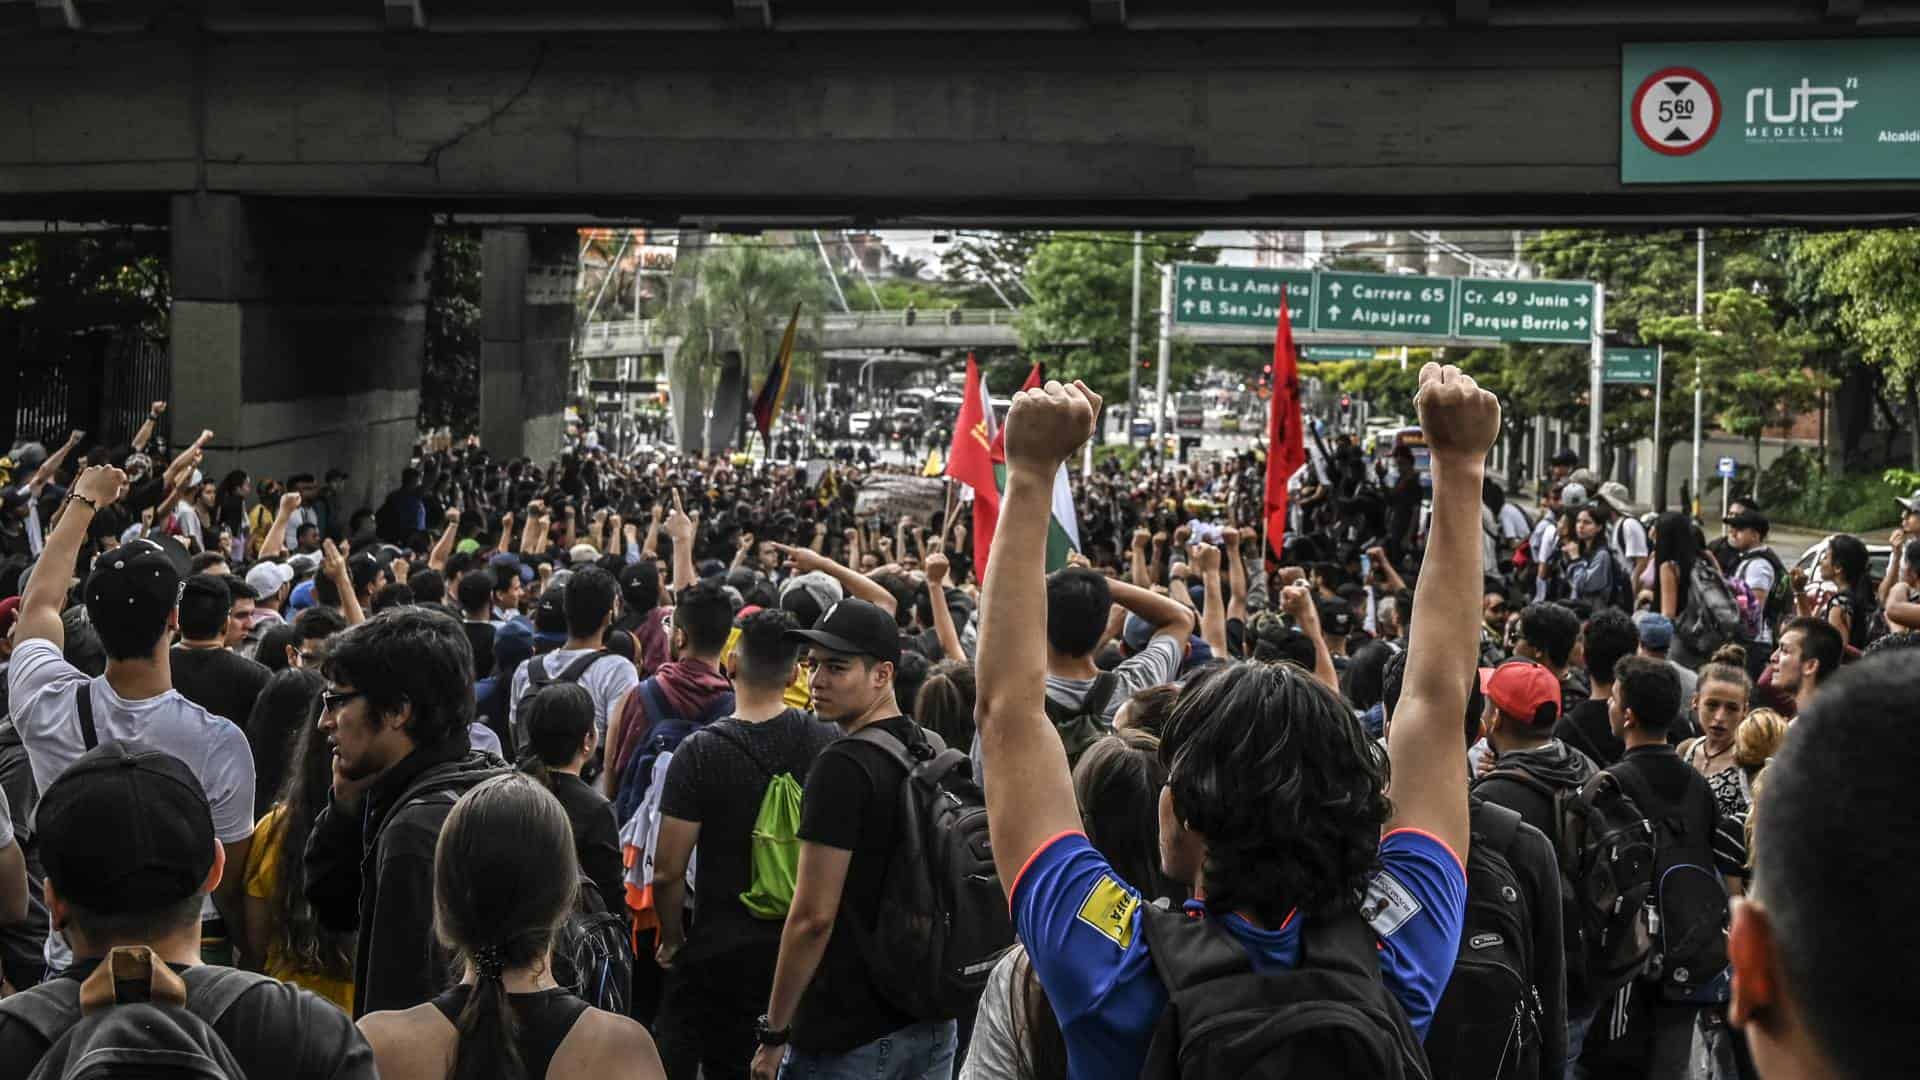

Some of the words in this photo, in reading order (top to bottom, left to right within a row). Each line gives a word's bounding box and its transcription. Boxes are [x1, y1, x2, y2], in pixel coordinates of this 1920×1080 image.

[1745, 126, 1843, 138] MEDELLÍN
[1219, 278, 1238, 292] La
[1244, 279, 1309, 296] Améica
[1352, 284, 1412, 301] Carrera
[1421, 287, 1445, 302] 65
[1464, 289, 1486, 304] Cr.
[1493, 290, 1517, 305] 49
[1218, 301, 1248, 316] San
[1251, 303, 1303, 319] Javer
[1463, 312, 1518, 330] Parque
[1110, 894, 1130, 920] FIFA
